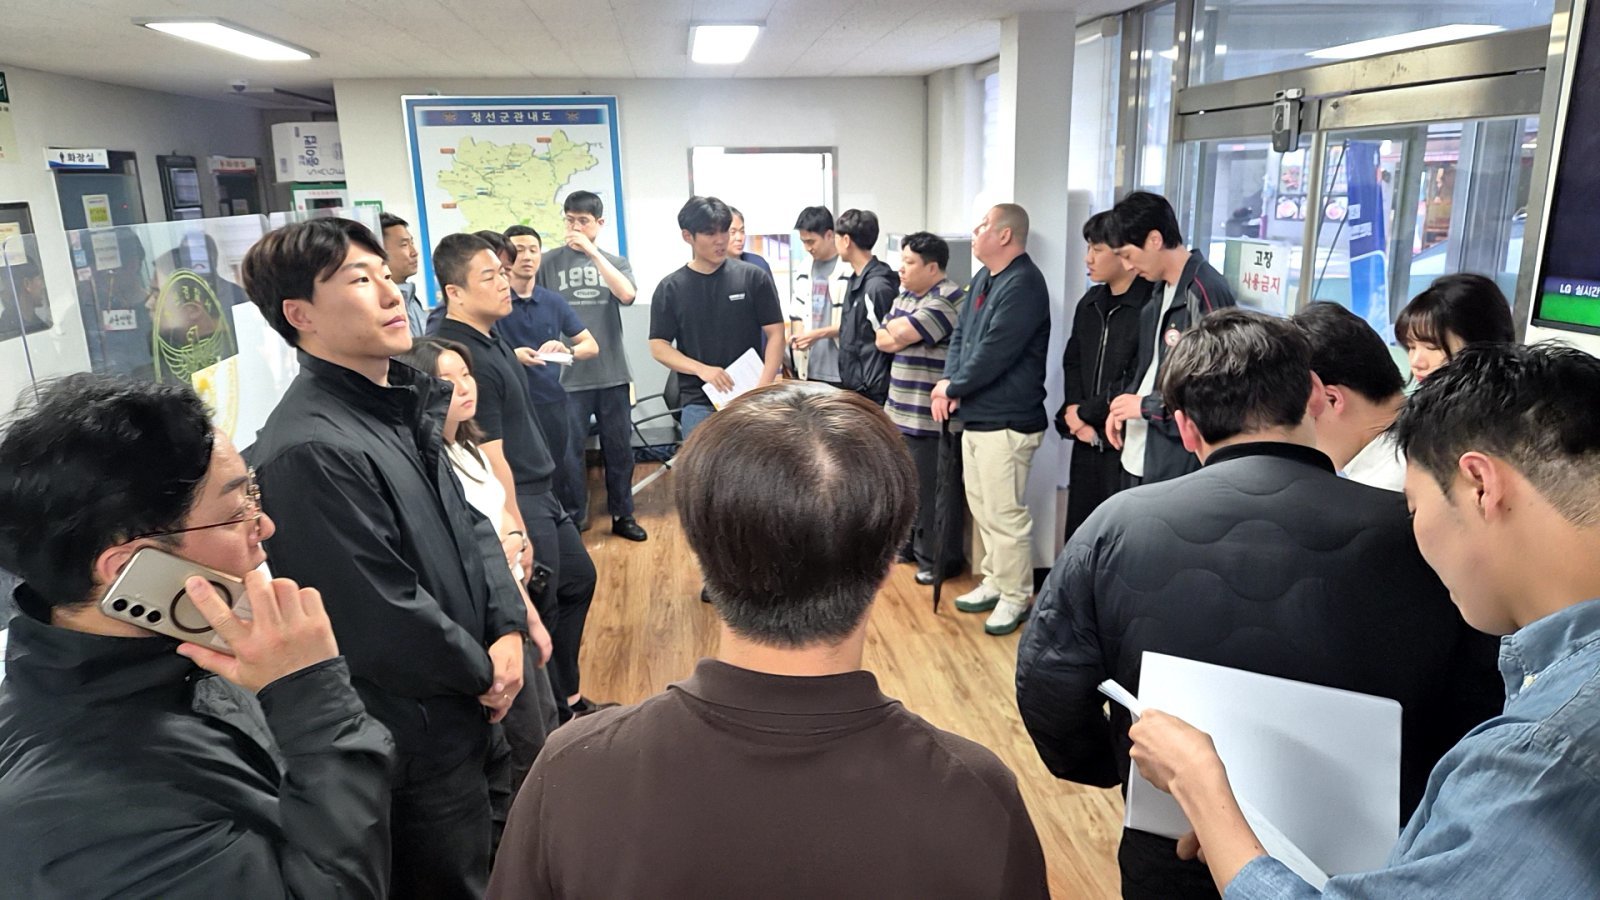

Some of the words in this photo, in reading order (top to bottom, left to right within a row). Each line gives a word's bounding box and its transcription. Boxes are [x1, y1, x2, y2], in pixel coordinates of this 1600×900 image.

[471, 111, 552, 123] 정선군관내도
[67, 153, 94, 162] 화장실
[303, 135, 319, 167] 종이컵
[1254, 251, 1273, 269] 고장
[1242, 272, 1281, 295] 사용금지
[1560, 284, 1572, 294] LG
[1575, 285, 1600, 298] 실시간
